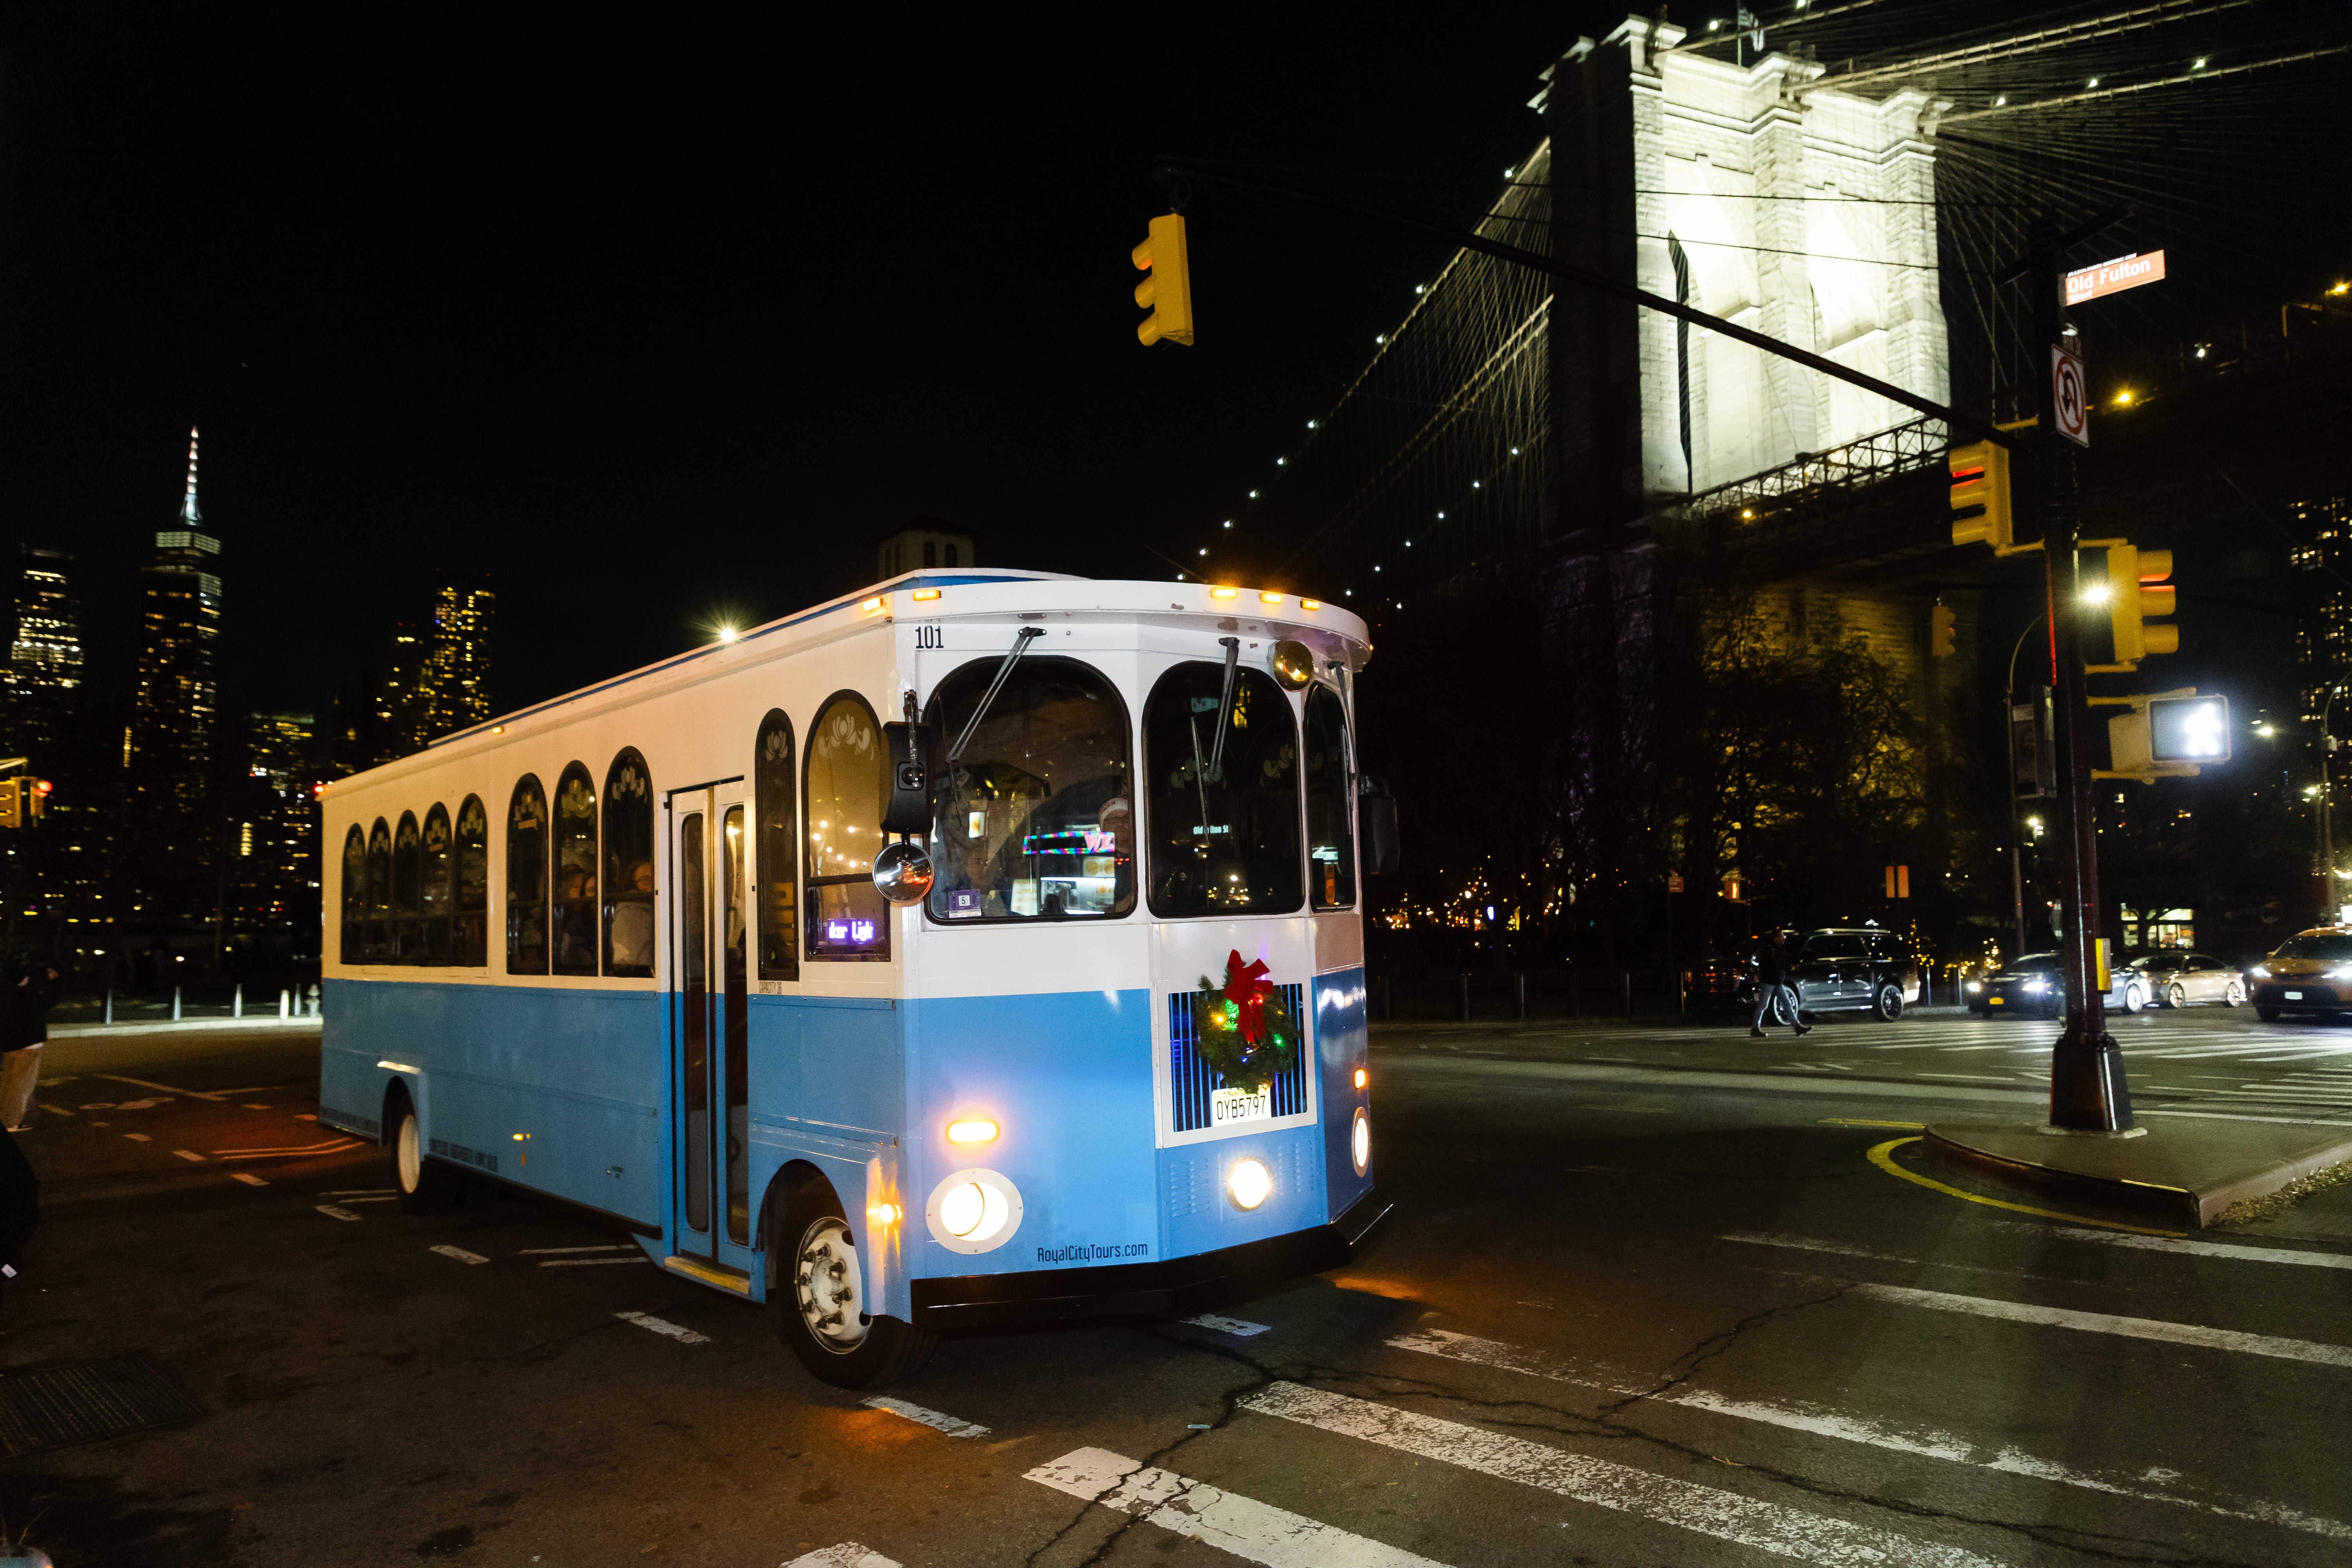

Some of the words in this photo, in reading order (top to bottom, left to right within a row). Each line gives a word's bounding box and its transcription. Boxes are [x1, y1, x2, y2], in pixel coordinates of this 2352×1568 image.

[2068, 273, 2094, 294] Old
[2099, 260, 2151, 285] Fulton
[2069, 290, 2092, 303] Street
[915, 625, 944, 649] 101
[1037, 1243, 1148, 1264] RoyalCityTours.com
